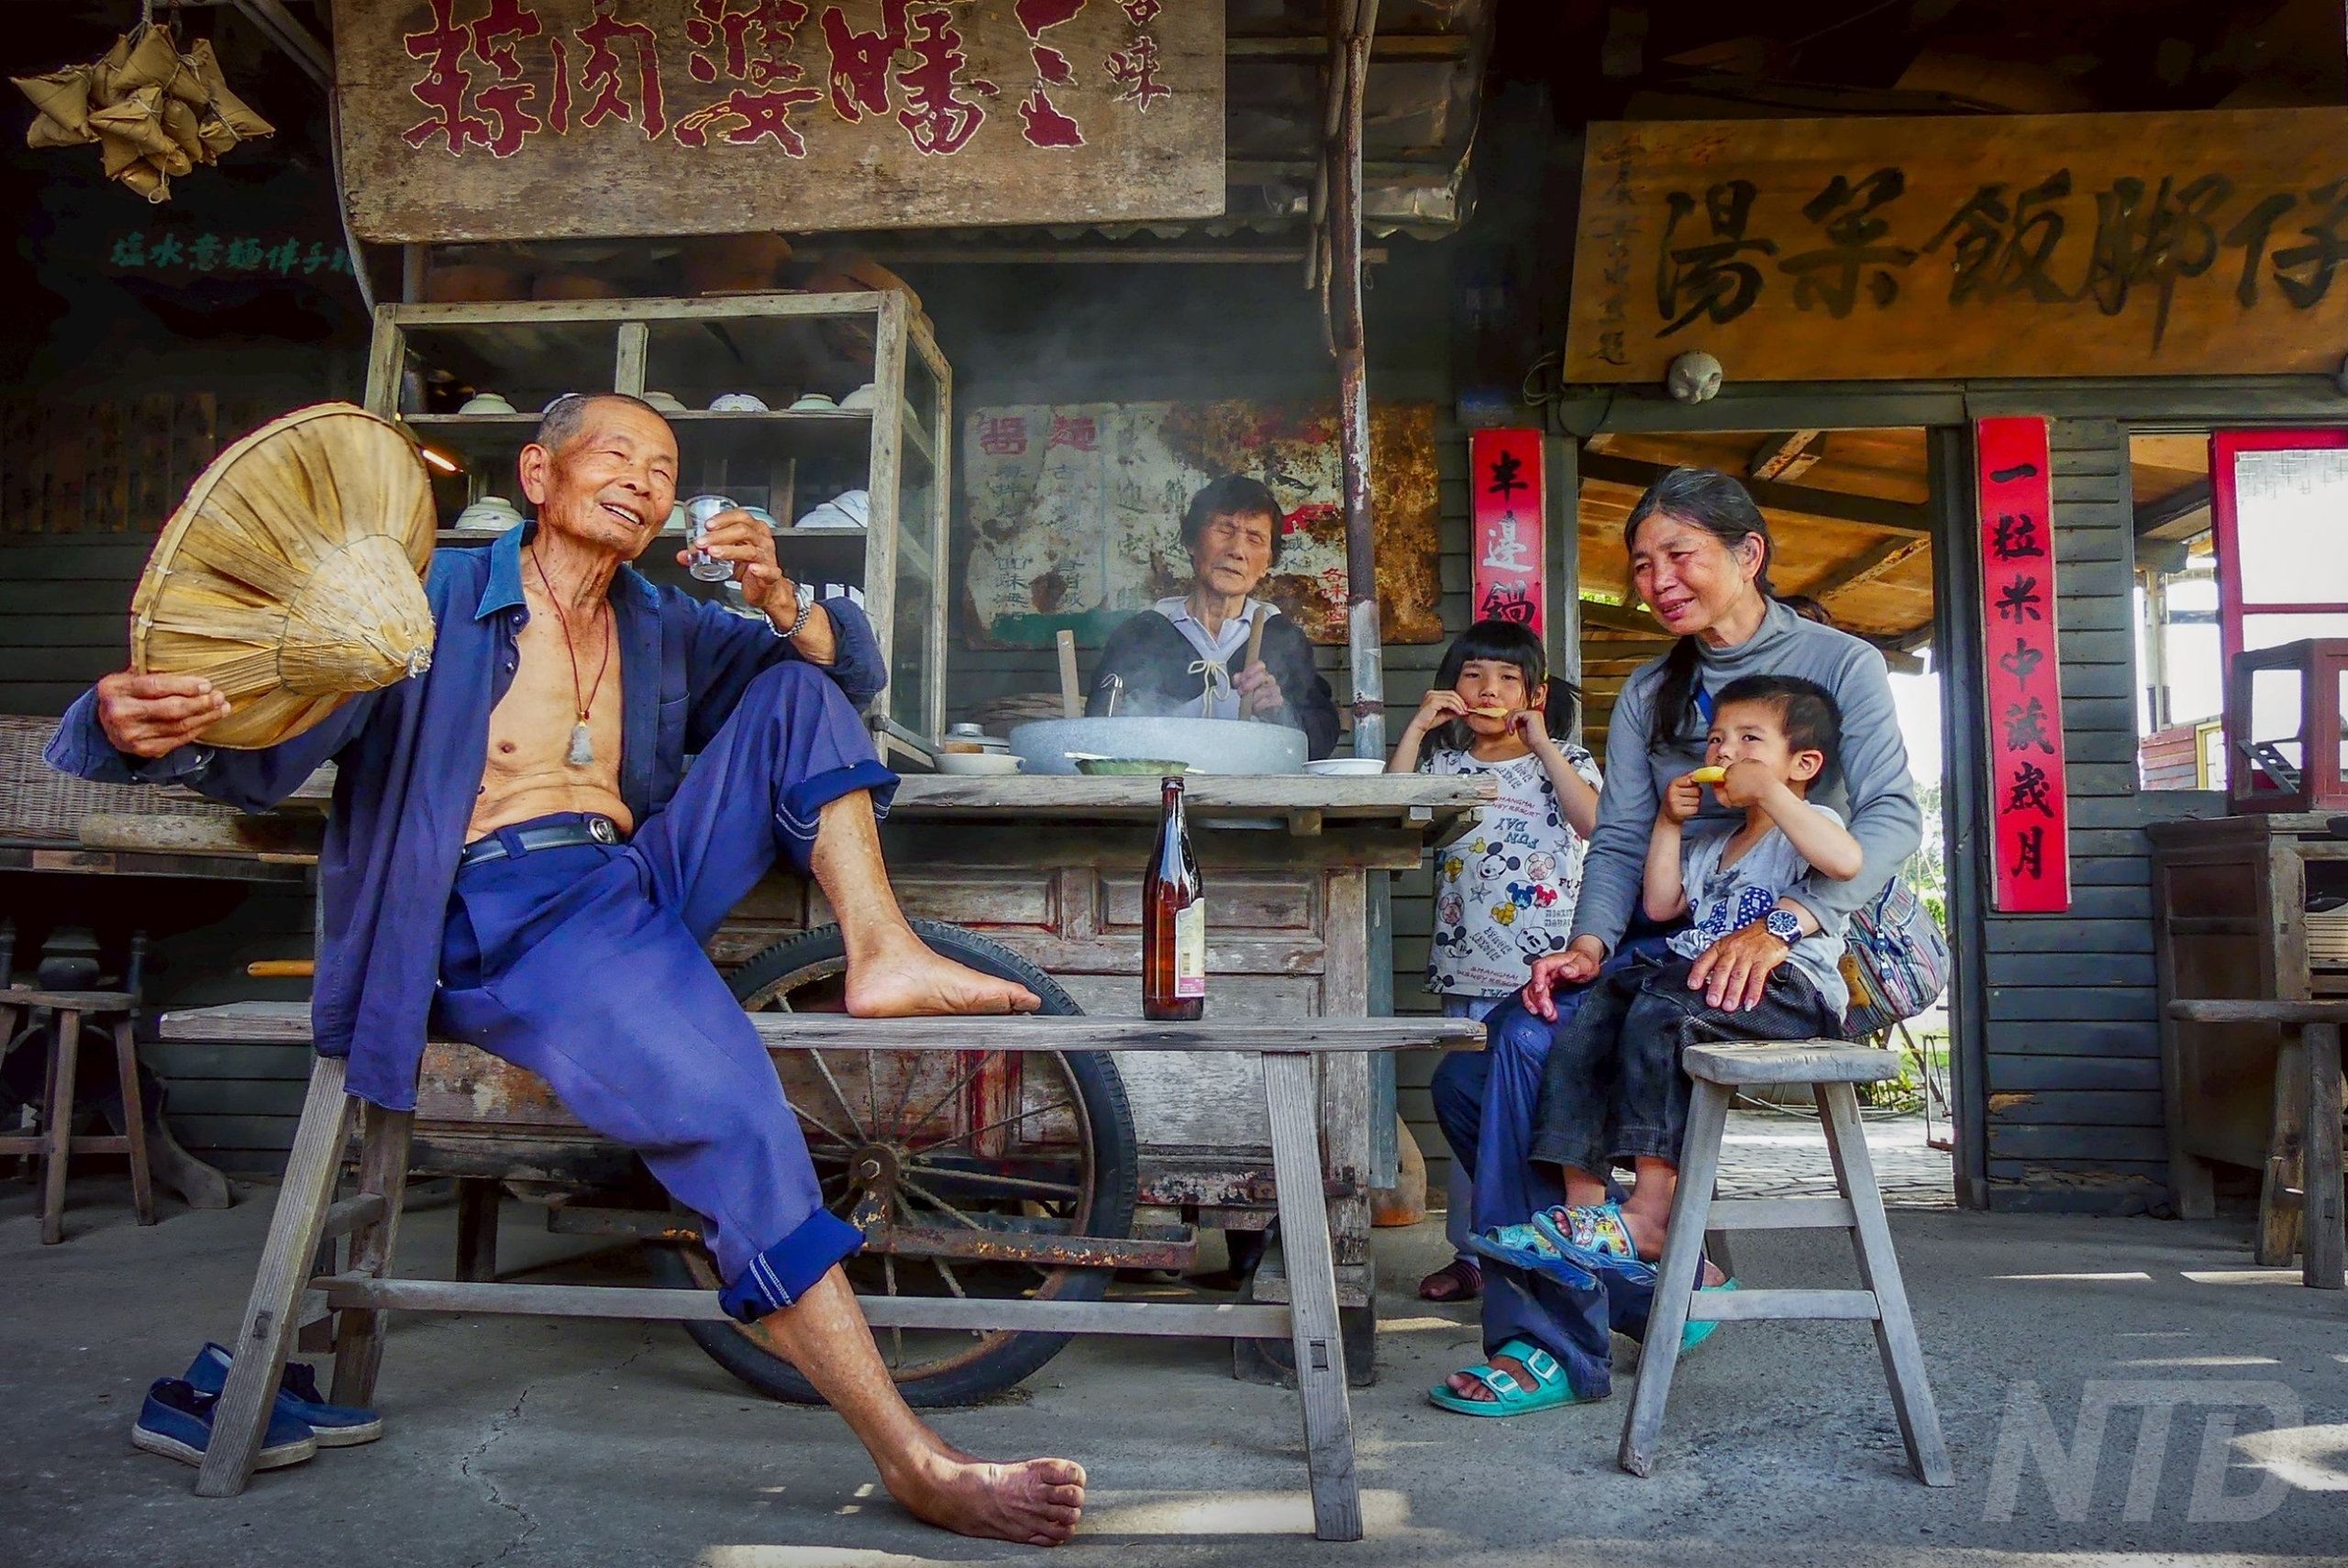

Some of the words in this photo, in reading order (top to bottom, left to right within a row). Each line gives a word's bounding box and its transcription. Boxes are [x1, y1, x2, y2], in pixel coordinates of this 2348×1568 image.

[1989, 462, 2055, 880] 一粒米中藏歲月
[1498, 796, 1535, 809] HANGHAI
[1494, 818, 1527, 832] DAY
[1503, 833, 1539, 849] FUN
[1456, 969, 1487, 984] DISNEY
[1470, 966, 1519, 980] SHANGHAI
